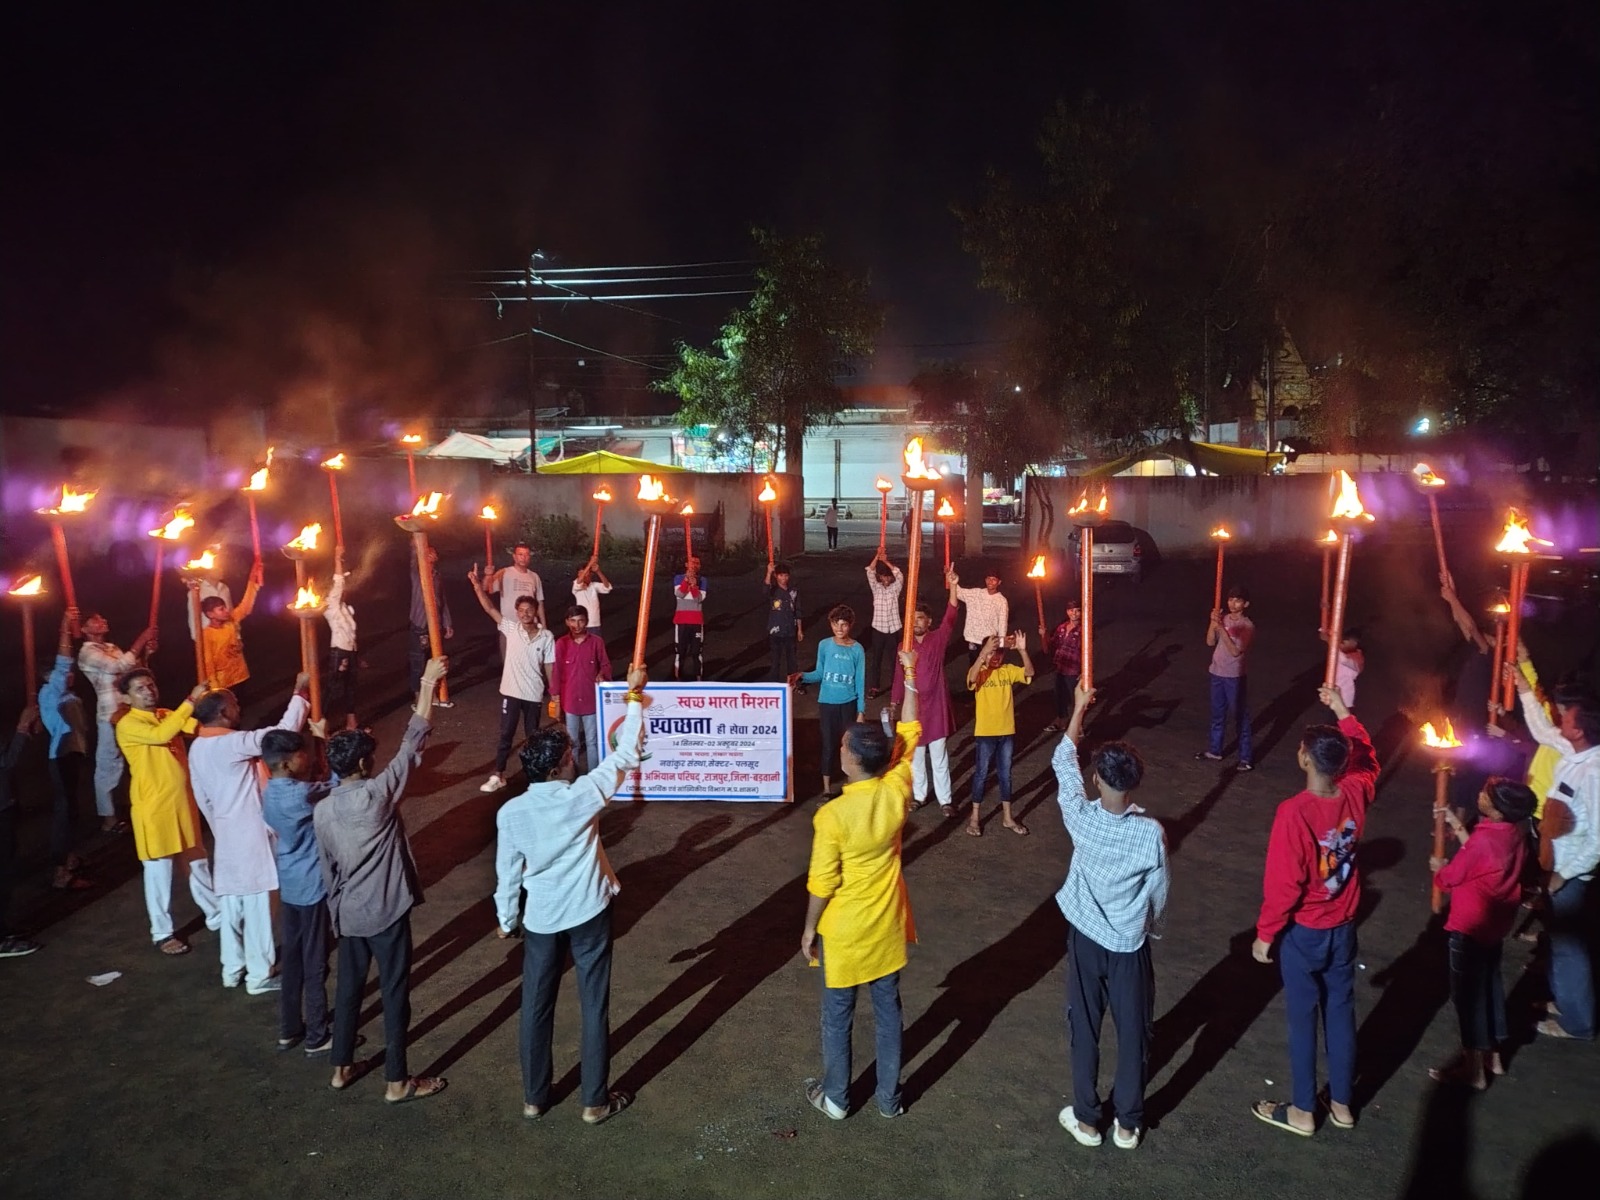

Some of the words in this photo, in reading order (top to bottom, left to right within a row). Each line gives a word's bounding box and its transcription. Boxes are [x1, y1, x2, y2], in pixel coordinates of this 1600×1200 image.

[677, 696, 706, 709] स्वच्छ
[708, 696, 738, 709] भारत
[740, 692, 780, 709] मिशन
[649, 717, 712, 735] स्वच्छता
[717, 723, 726, 735] ही
[730, 723, 748, 735] सेवा
[752, 725, 778, 735] 2024
[645, 770, 675, 781] अभियान
